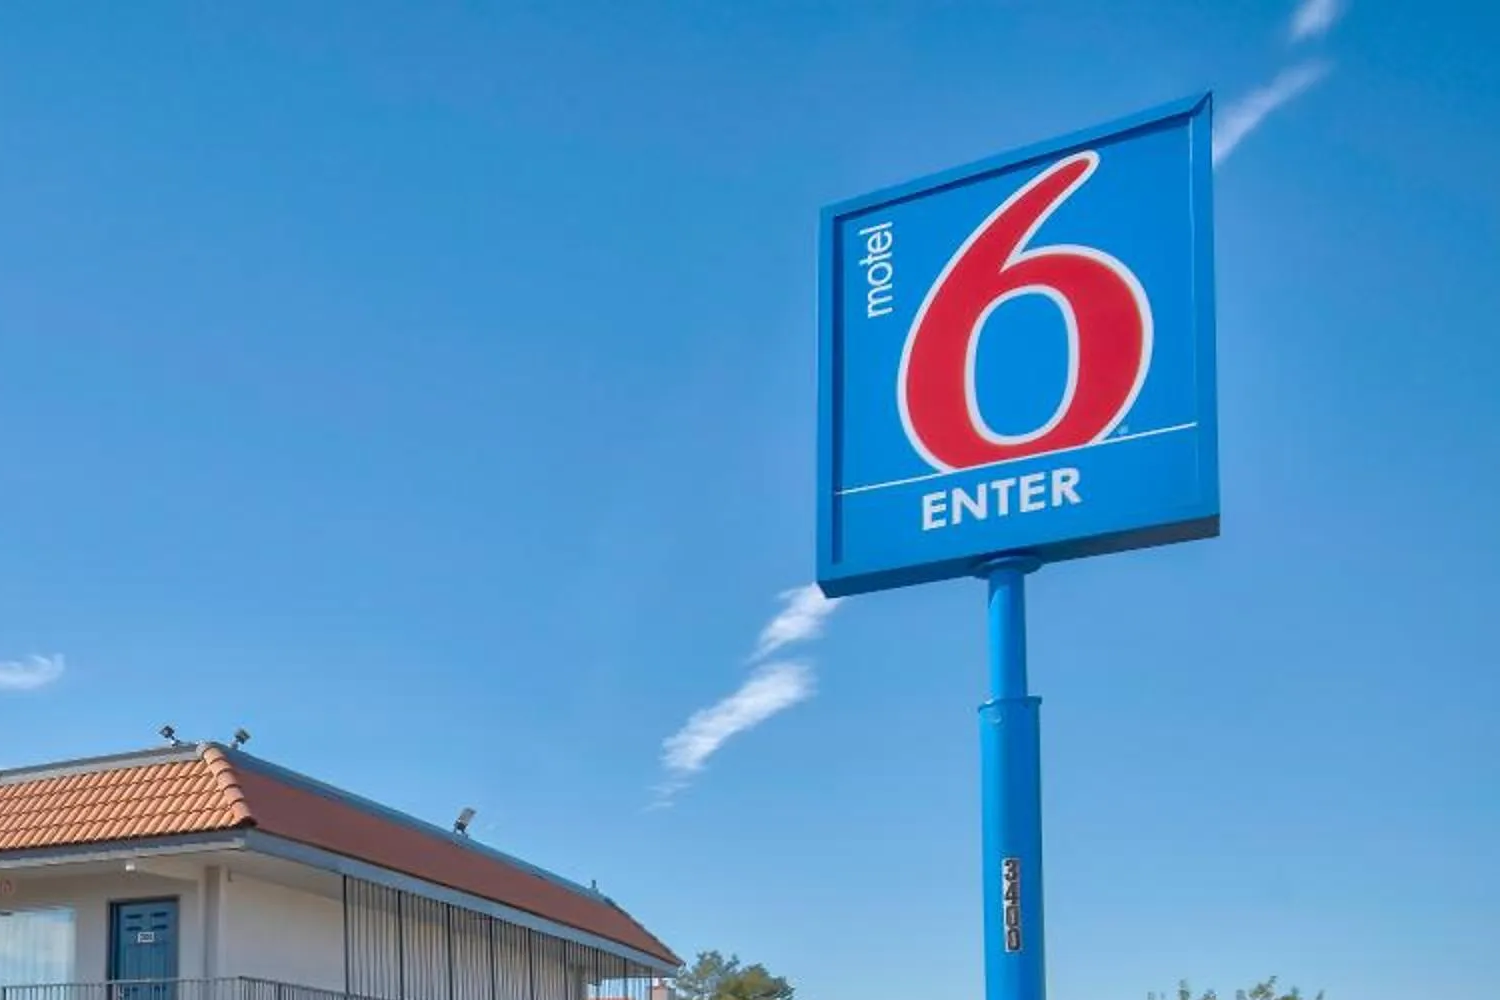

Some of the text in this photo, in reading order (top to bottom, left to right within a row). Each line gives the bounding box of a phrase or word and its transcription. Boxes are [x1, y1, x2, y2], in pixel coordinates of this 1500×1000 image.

[858, 150, 1153, 475] motel 6
[921, 467, 1082, 531] ENTER
[1003, 858, 1020, 951] 3400
